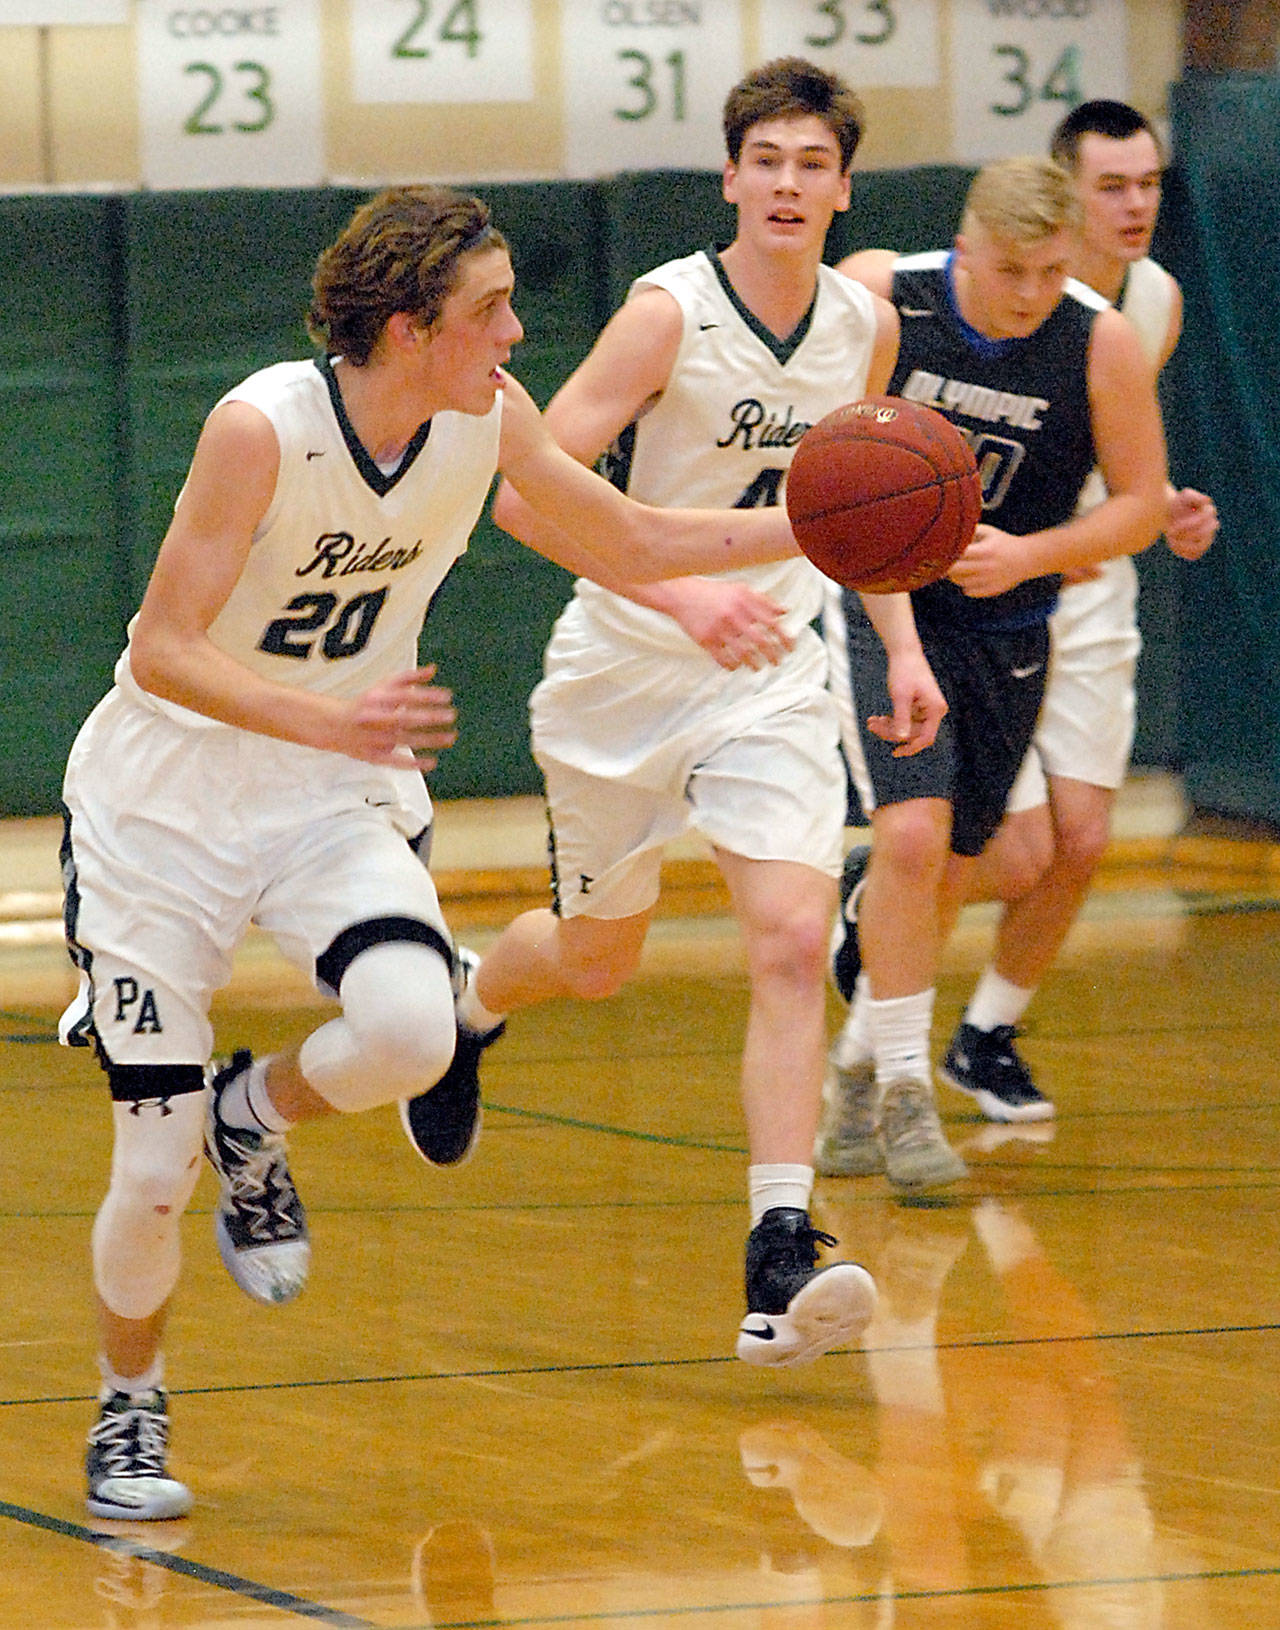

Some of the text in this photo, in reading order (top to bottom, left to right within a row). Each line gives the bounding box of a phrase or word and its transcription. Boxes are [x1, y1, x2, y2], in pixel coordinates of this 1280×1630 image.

[168, 8, 280, 38] COOKE
[390, 0, 482, 59] 24
[804, 0, 895, 47] 33
[183, 61, 274, 134] 23
[614, 48, 687, 122] 31
[990, 43, 1083, 118] 34
[716, 398, 814, 450] Ride
[295, 531, 423, 579] Riders
[256, 584, 390, 661] 20
